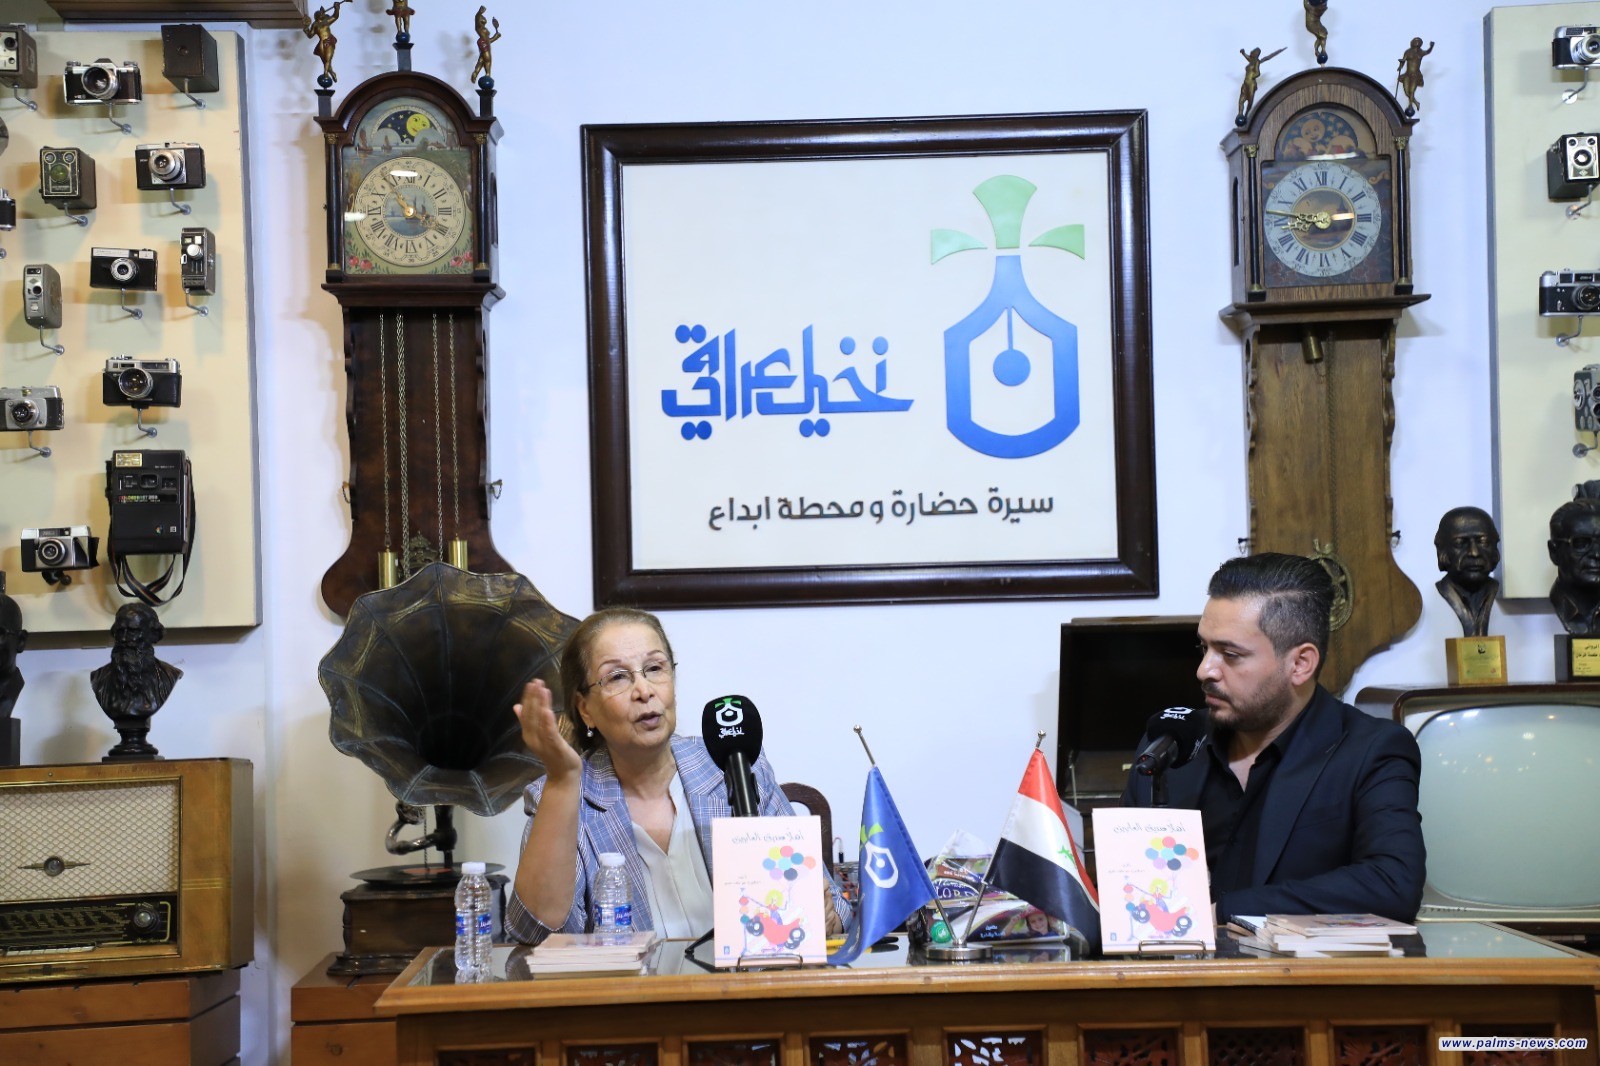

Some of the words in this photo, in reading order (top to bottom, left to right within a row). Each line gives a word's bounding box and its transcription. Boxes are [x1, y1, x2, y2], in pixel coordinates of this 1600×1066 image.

[661, 323, 799, 441] عراقي
[756, 323, 915, 438] نخيل
[708, 495, 771, 531] ابداع
[891, 489, 979, 526] حضارة
[987, 486, 1054, 524] سيرة
